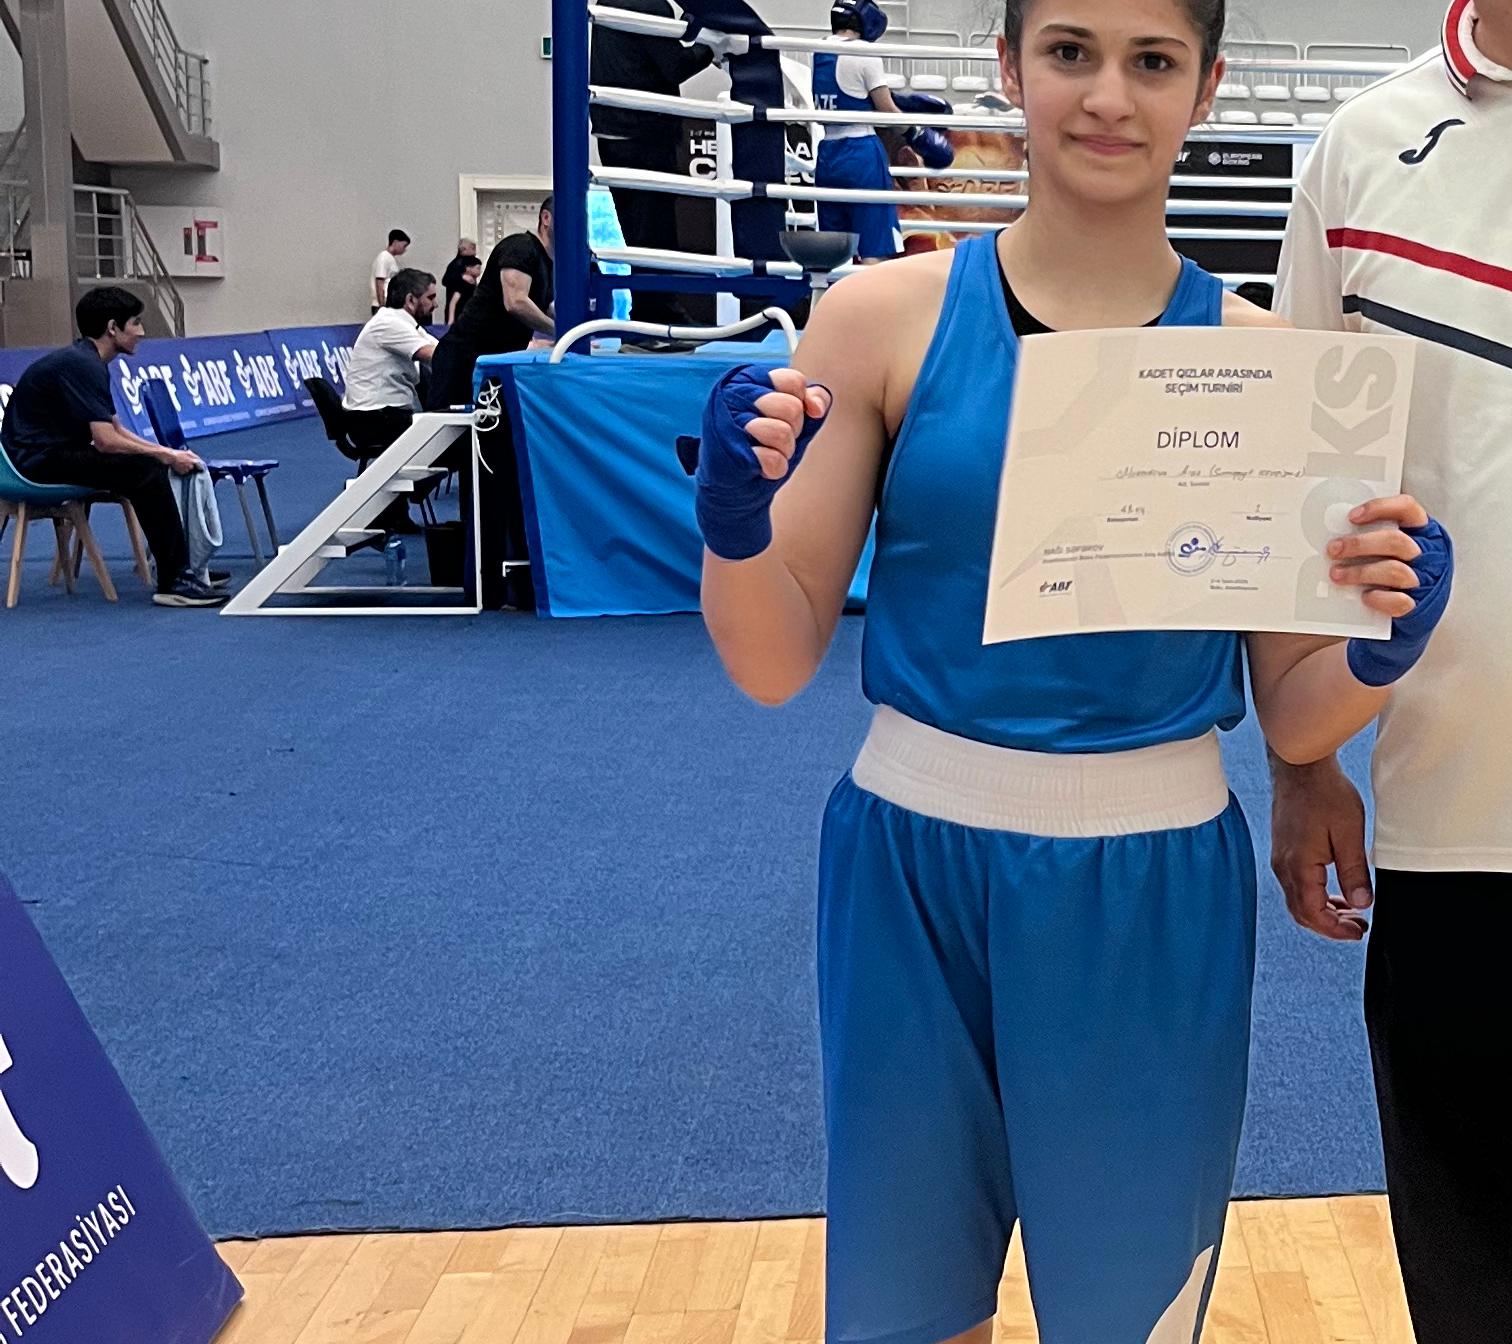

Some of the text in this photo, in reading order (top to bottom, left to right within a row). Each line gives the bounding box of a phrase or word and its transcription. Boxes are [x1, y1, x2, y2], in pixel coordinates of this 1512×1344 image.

[198, 360, 235, 406] ABF
[249, 355, 284, 398] ABF
[1138, 368, 1273, 379] KADET QIZLAR ARASINDA
[1157, 427, 1239, 449] DİPLOM
[1, 1185, 136, 1337] FEDERASİYASI
